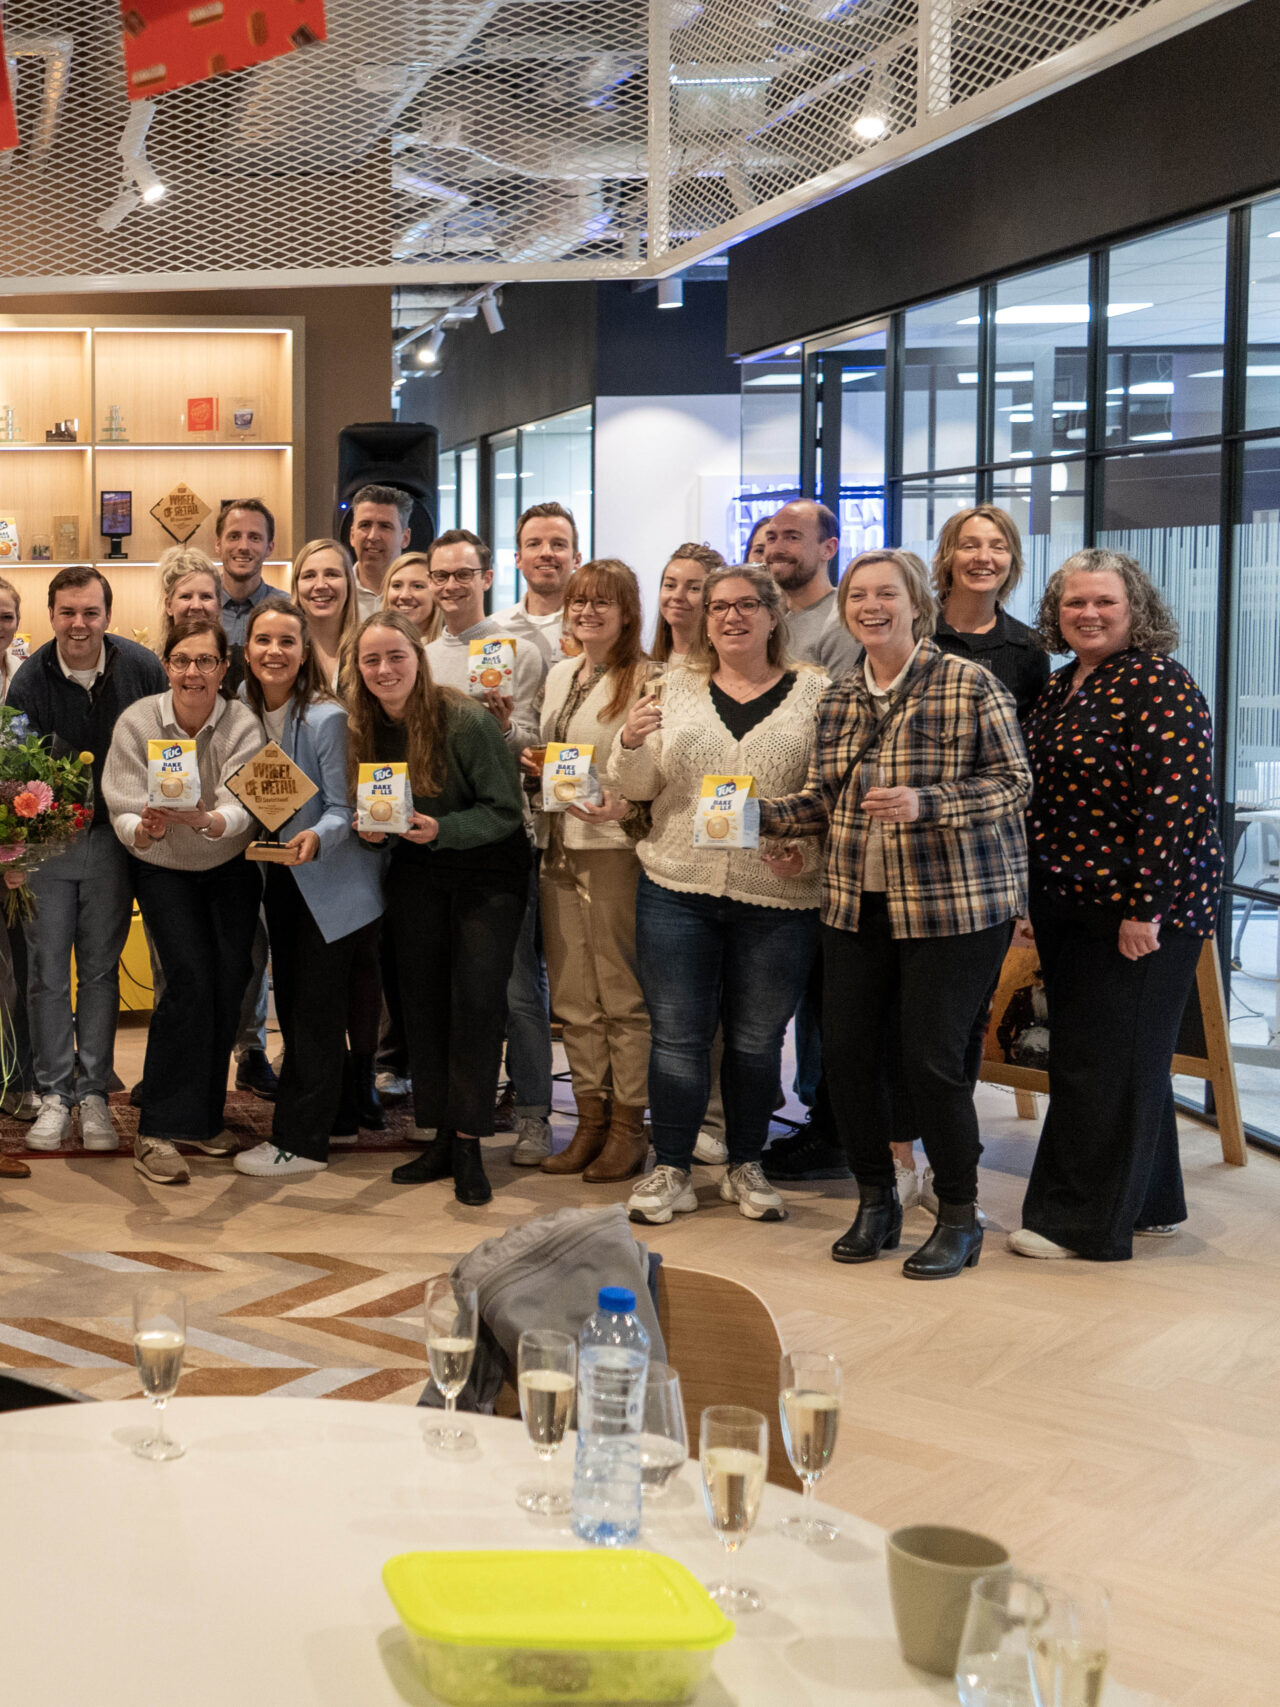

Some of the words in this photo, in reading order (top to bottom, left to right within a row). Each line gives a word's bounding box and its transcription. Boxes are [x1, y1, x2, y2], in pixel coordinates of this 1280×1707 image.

[163, 747, 182, 760] TUC
[560, 749, 578, 761] TUC
[374, 768, 392, 781] TUC
[716, 784, 735, 796] TUC
